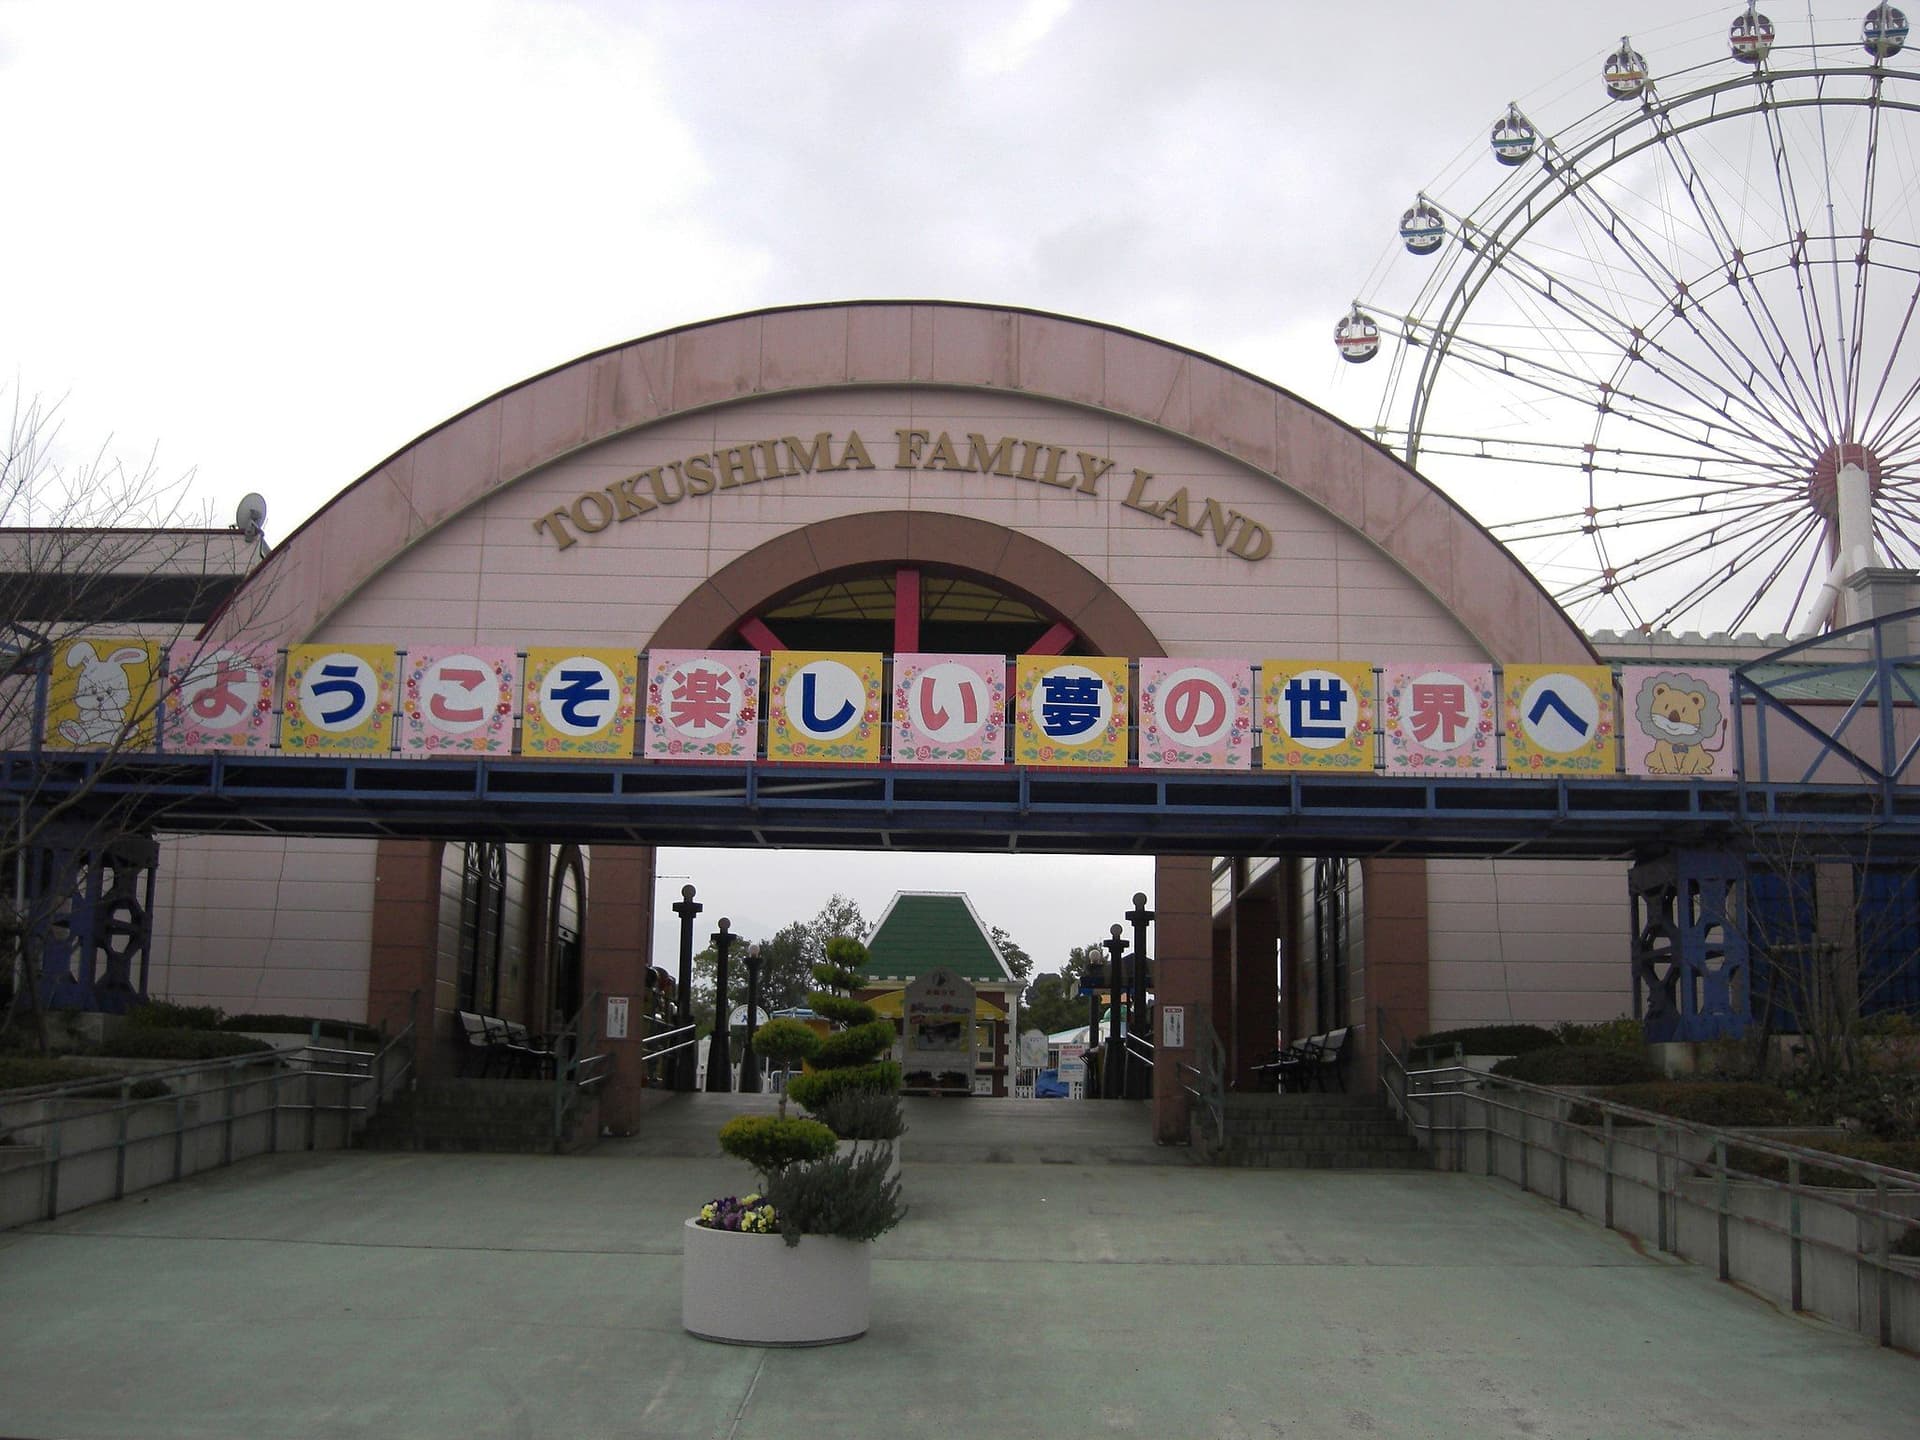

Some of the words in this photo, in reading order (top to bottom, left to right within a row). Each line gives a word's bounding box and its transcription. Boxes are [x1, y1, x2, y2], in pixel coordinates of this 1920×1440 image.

[534, 429, 874, 551] TOKUSHIMA
[895, 428, 1115, 496] FAMILY
[1121, 469, 1274, 562] LAND
[195, 660, 1589, 742] ようこそ楽しい夢の世界へ
